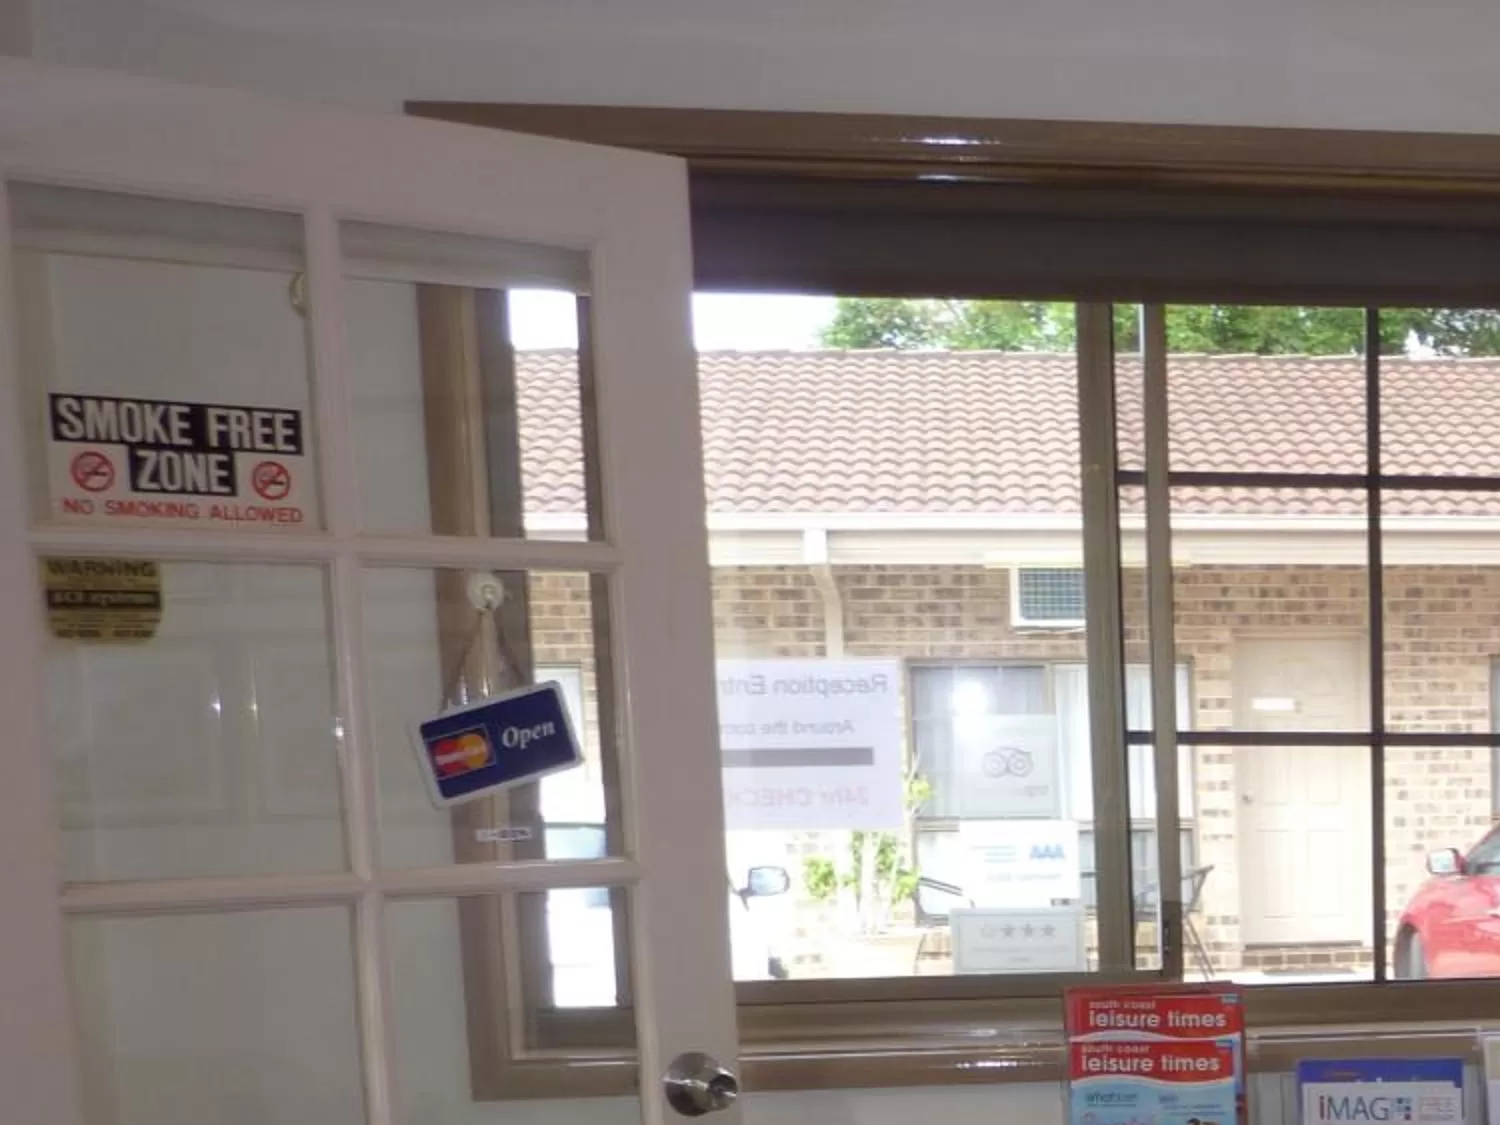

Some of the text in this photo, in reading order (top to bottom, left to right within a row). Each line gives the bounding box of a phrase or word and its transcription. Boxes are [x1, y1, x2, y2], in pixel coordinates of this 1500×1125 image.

[56, 396, 298, 452] SMOKE FREE
[135, 450, 233, 493] ZONE
[63, 497, 304, 524] NO SMOKING ALLOWED
[47, 558, 157, 578] WARNING
[502, 720, 557, 750] Open
[1088, 1009, 1227, 1028] leisure times
[1081, 1054, 1221, 1072] leisure times
